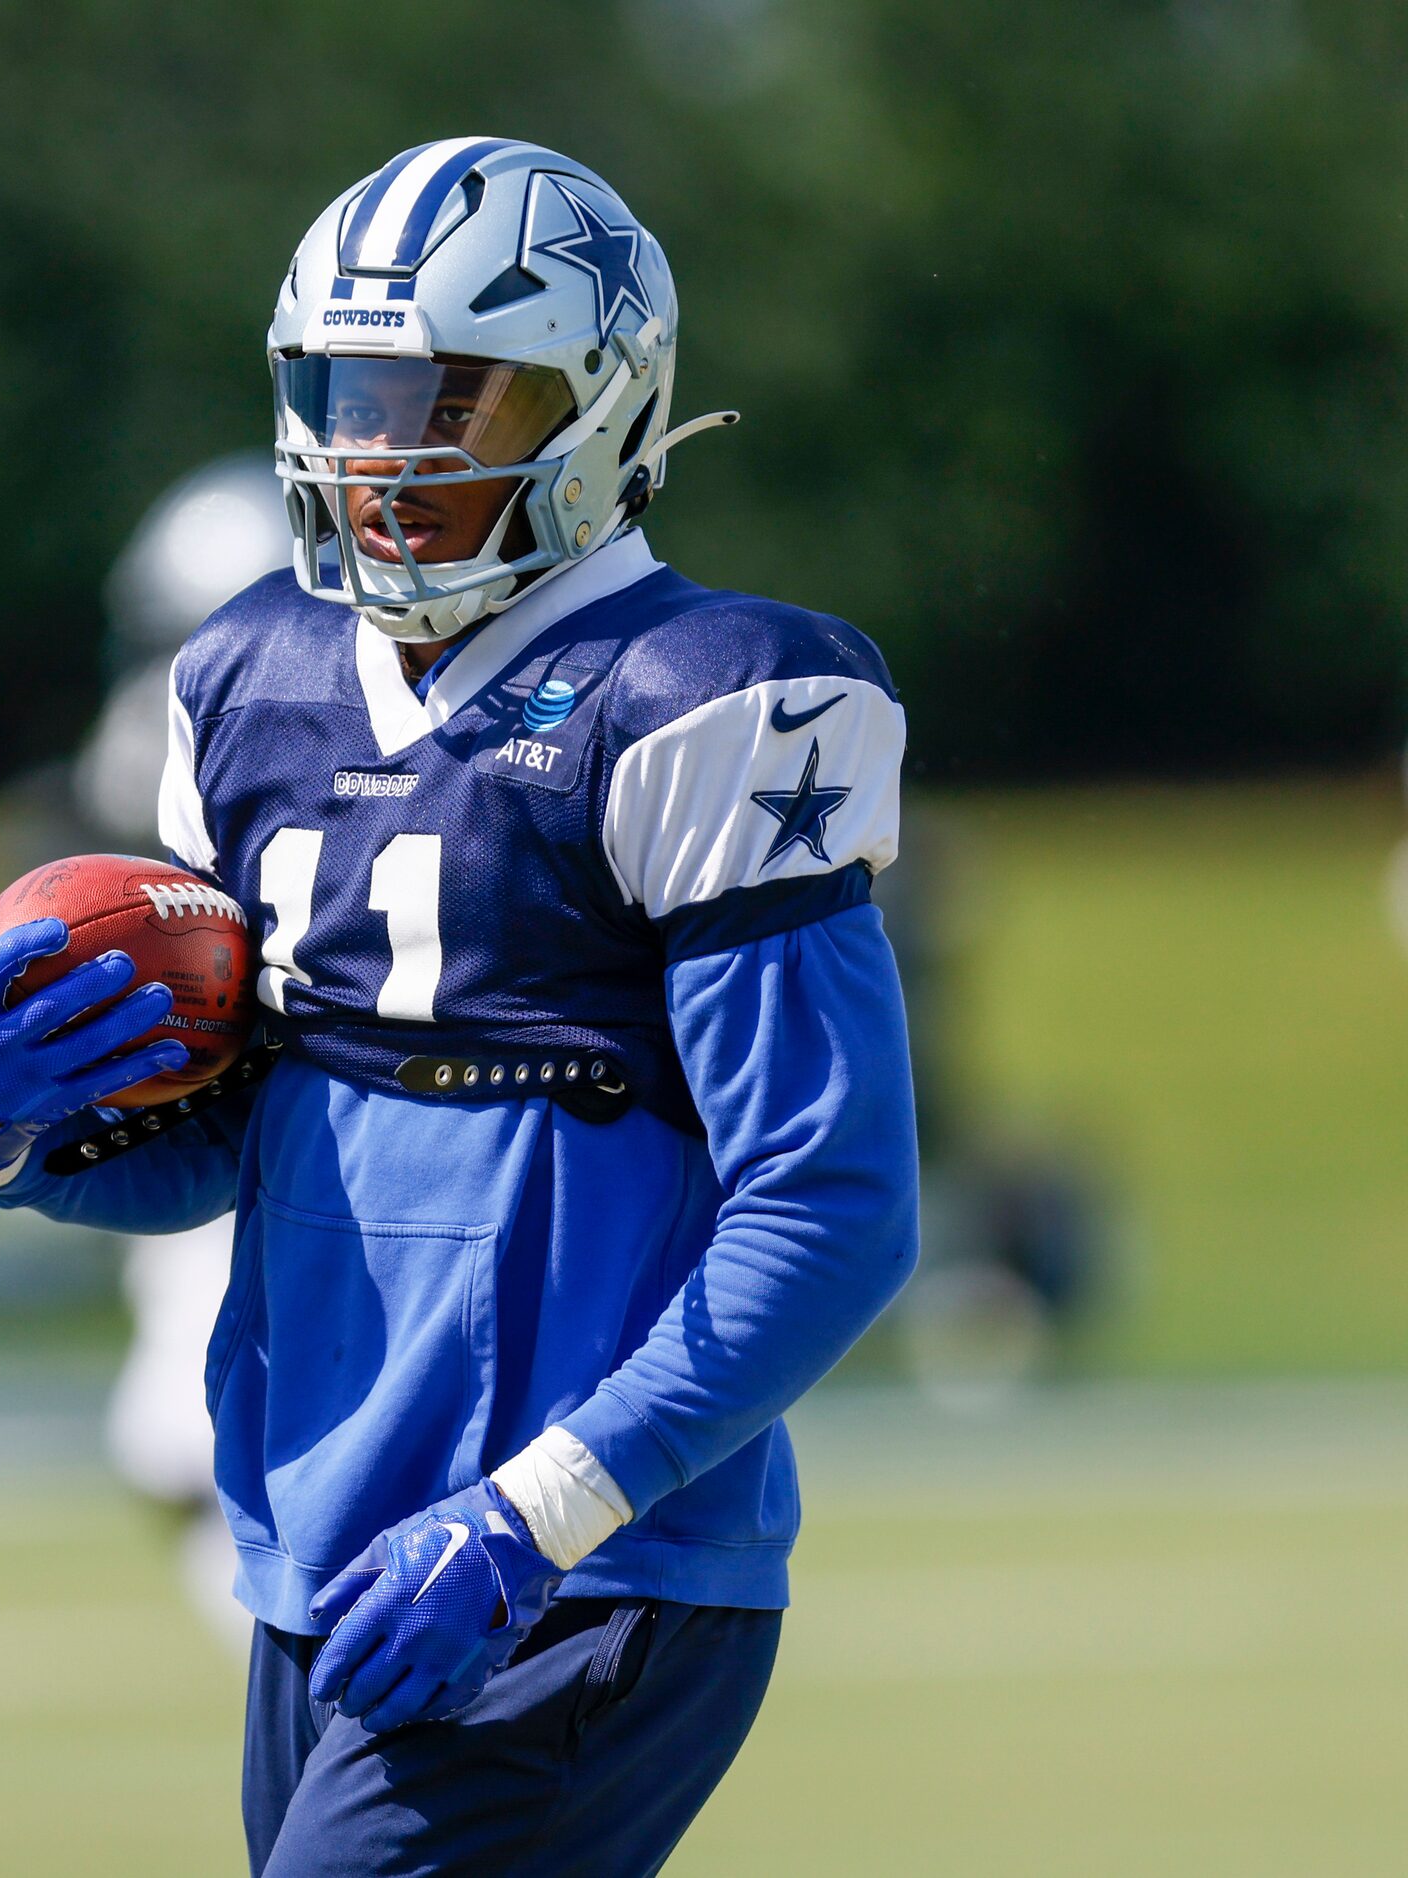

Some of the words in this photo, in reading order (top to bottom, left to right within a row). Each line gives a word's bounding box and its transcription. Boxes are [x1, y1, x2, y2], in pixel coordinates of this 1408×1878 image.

[323, 310, 405, 327] COWBOYS
[494, 737, 563, 772] AT&T
[334, 771, 419, 796] COWBOYS
[259, 827, 442, 1022] 11
